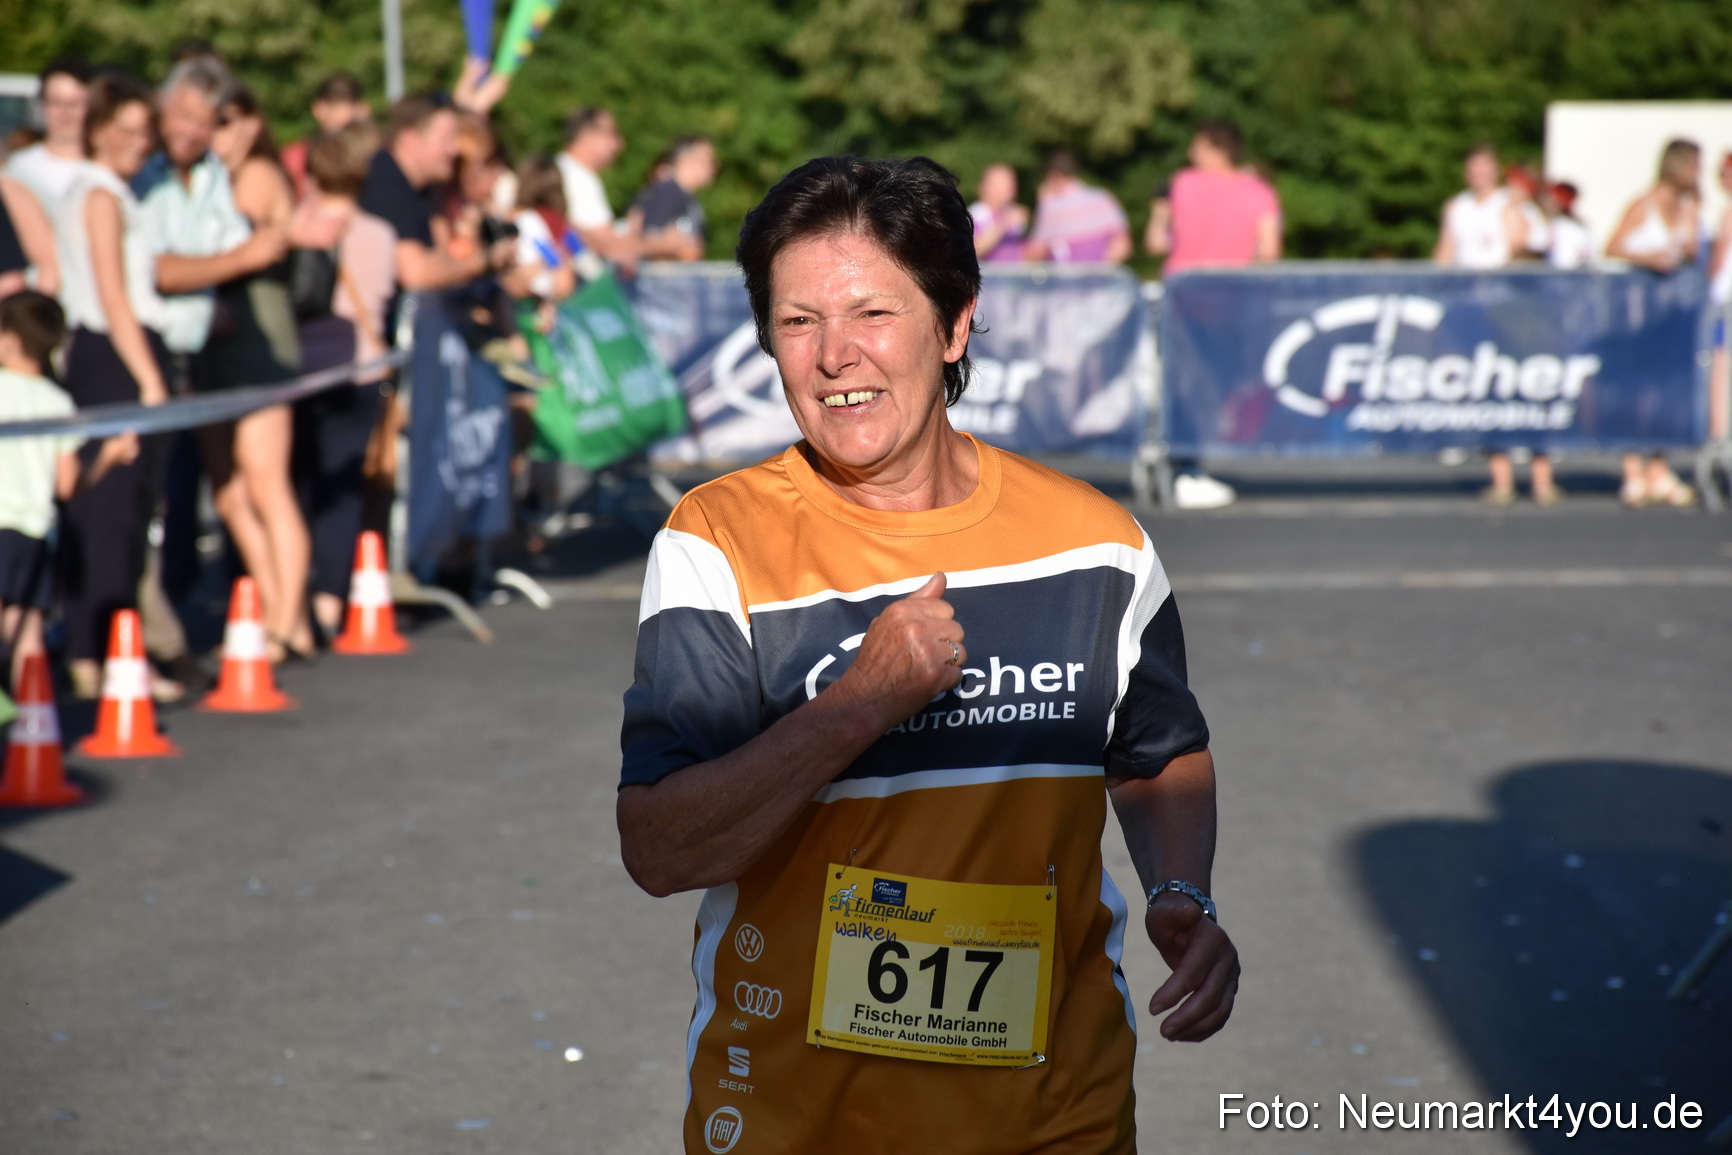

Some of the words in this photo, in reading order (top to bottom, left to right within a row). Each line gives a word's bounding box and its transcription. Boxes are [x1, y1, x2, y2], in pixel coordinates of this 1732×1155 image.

[1323, 340, 1602, 402] Fischer
[1346, 402, 1576, 433] AUTOMOBILE
[929, 656, 1084, 702] cher
[853, 912, 889, 923] neumarkt
[855, 897, 937, 923] firmenlauf
[835, 921, 897, 942] walken
[944, 923, 986, 939] 2018
[867, 940, 1004, 1012] 617
[730, 1017, 748, 1031] Audi
[854, 1003, 922, 1027] Fischer
[927, 1013, 1008, 1033] Marianne
[849, 1021, 895, 1038] Fischer
[897, 1029, 968, 1047] Automobile
[971, 1035, 1007, 1048] GmbH
[718, 1079, 755, 1094] SEAT
[712, 1119, 736, 1142] FIAT
